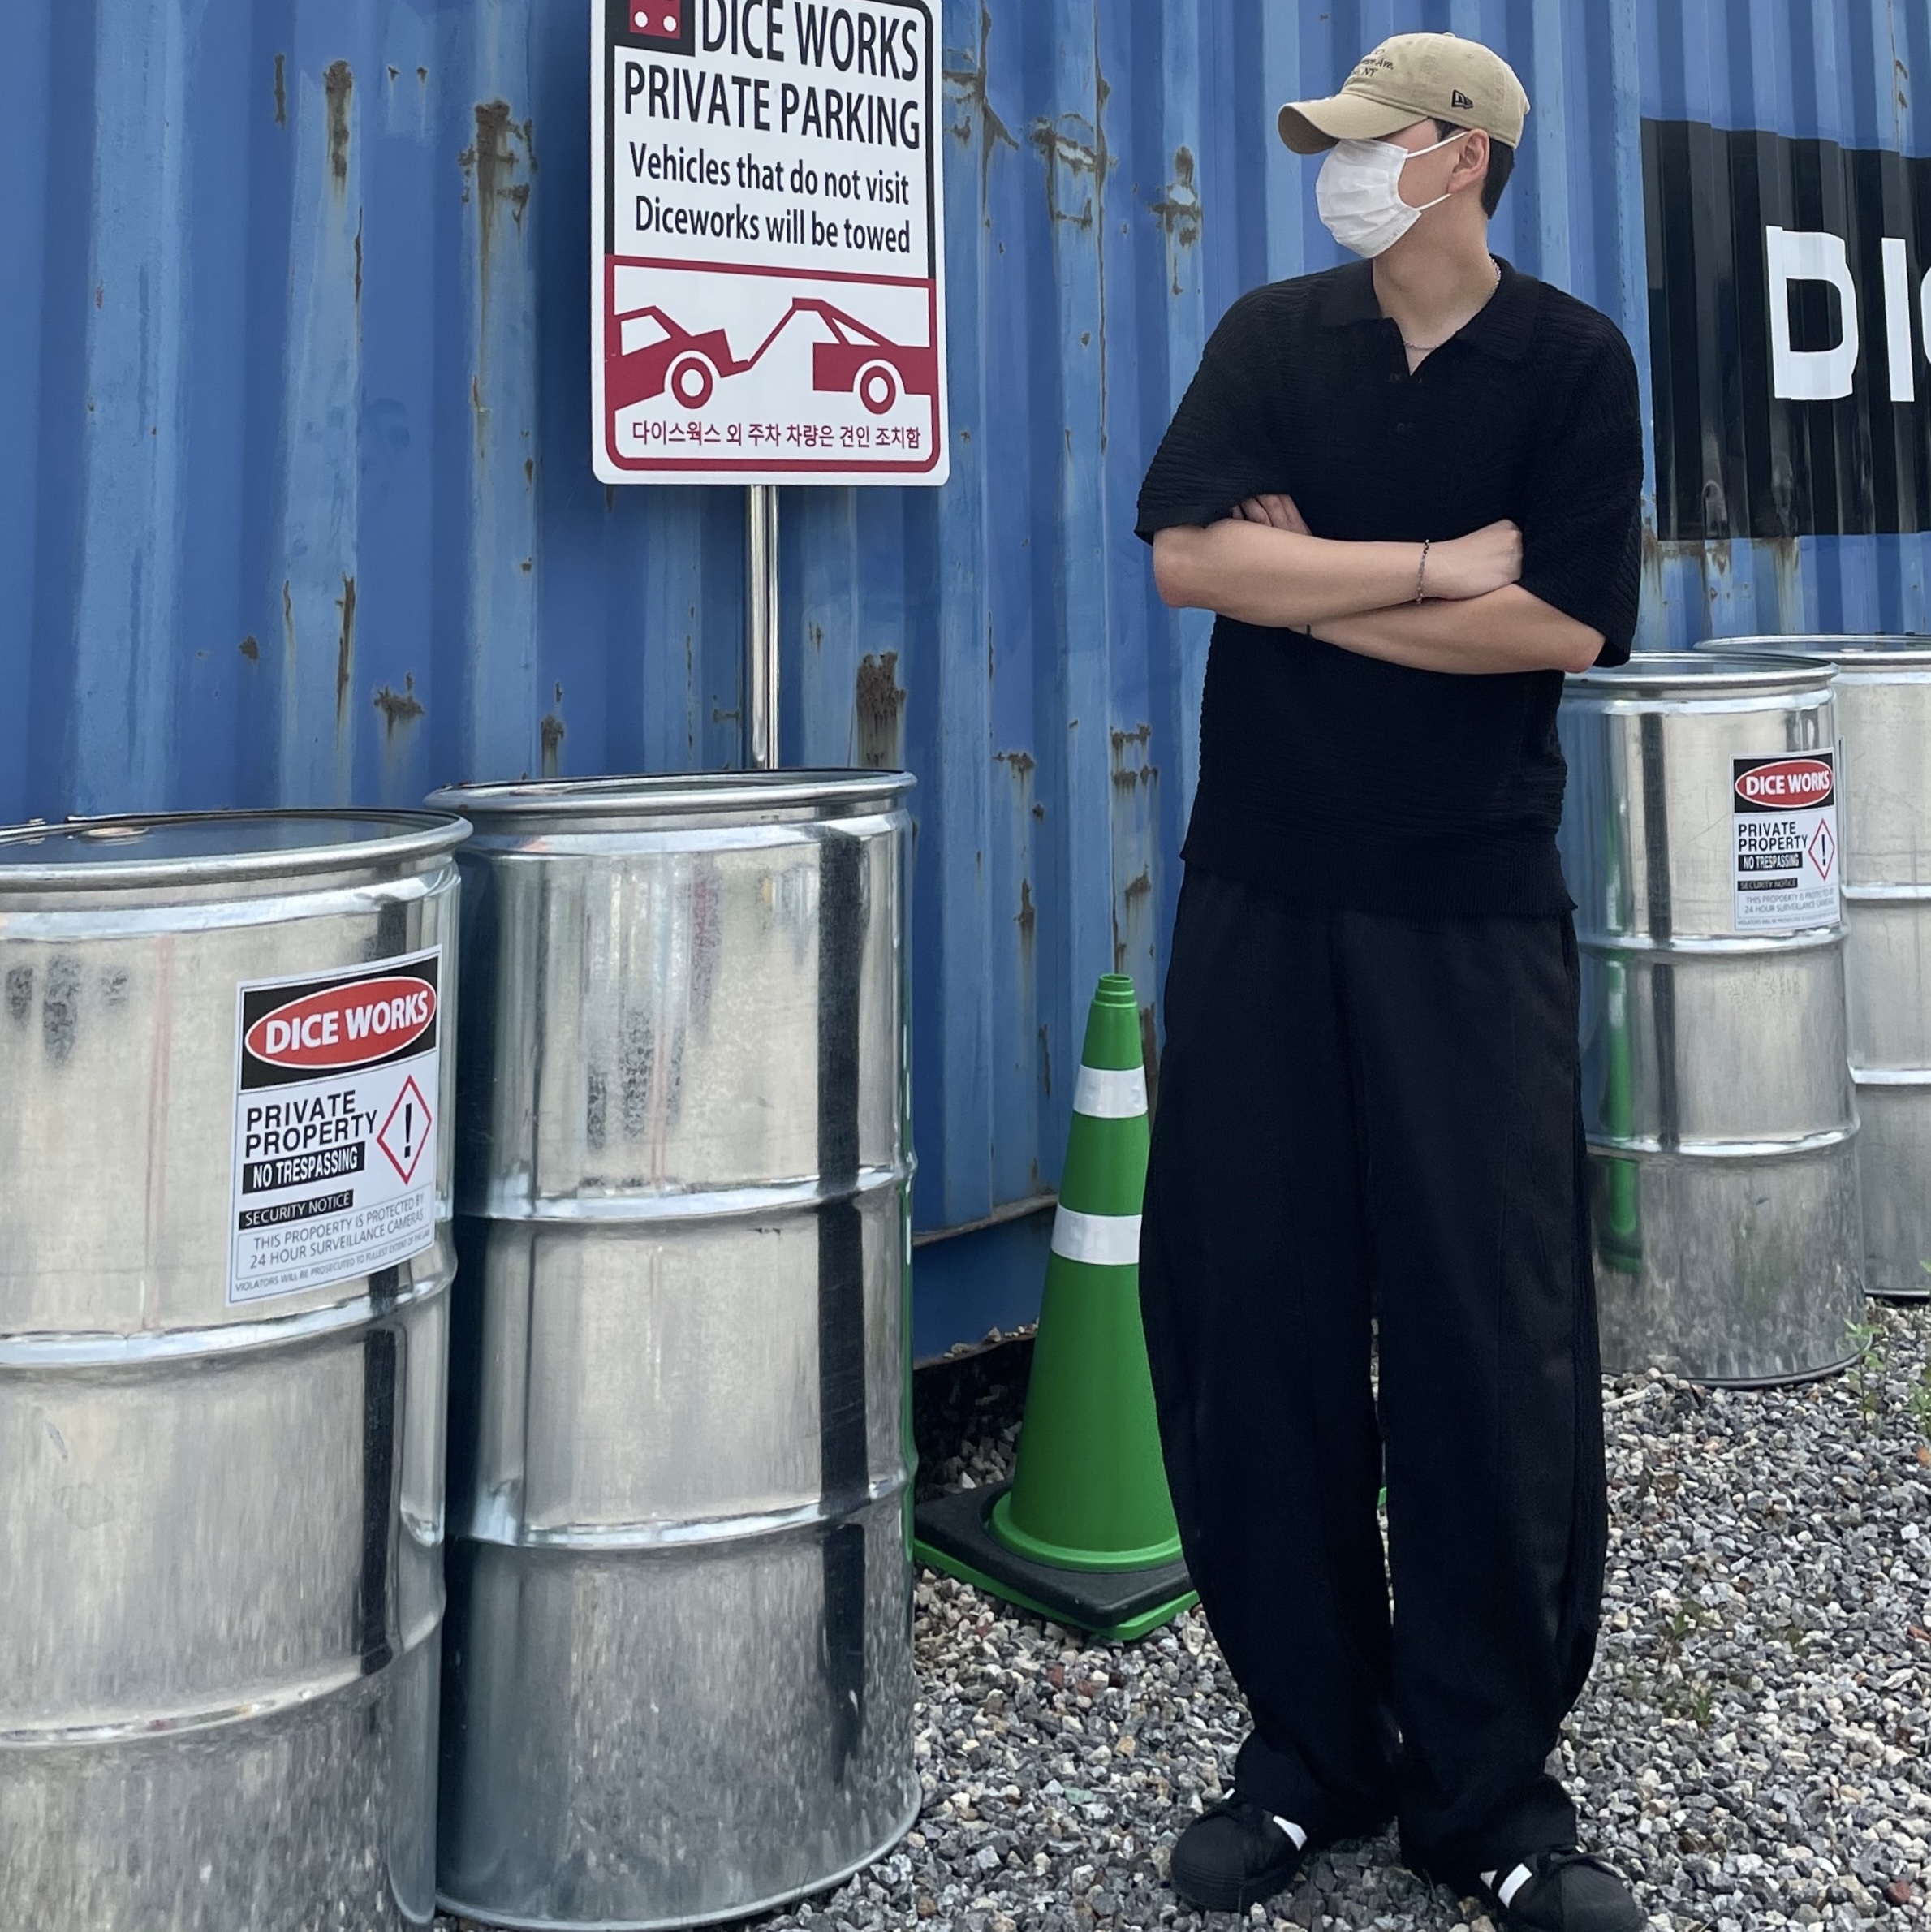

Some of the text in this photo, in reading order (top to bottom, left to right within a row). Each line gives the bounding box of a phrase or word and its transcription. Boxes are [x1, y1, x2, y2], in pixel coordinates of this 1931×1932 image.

[702, 0, 919, 81] DICE WORKS
[624, 62, 920, 149] PRIVATE PARKING
[629, 141, 909, 205] Vehicles that do not visit
[636, 196, 910, 253] Diceworks will be towed
[1765, 225, 1931, 403] DI
[632, 420, 921, 449] 다이스웍스 외 주차 차량은 견인 조치함
[1746, 770, 1830, 796] DICE WORKS
[1738, 822, 1796, 837] PRIVATE
[1738, 834, 1808, 852] PROPERTY
[1743, 853, 1800, 869] NO TRESPASSING
[1740, 880, 1772, 890] SECURITY
[1744, 906, 1753, 914] 24
[1756, 904, 1775, 913] HOUR
[265, 990, 428, 1054] DICE WORKS
[247, 1089, 356, 1132] PRIVATE
[245, 1109, 377, 1158] PROPERTY
[253, 1145, 358, 1188] NO TRESPASSING
[245, 1192, 350, 1227] SECURITY NOTICE
[254, 1192, 425, 1252] THIS PROPOERTY IS PROTECTED BY
[250, 1208, 424, 1270] 24 HOUR SURVEILLANCE CAMERAS
[235, 1275, 278, 1292] VIOLATORS
